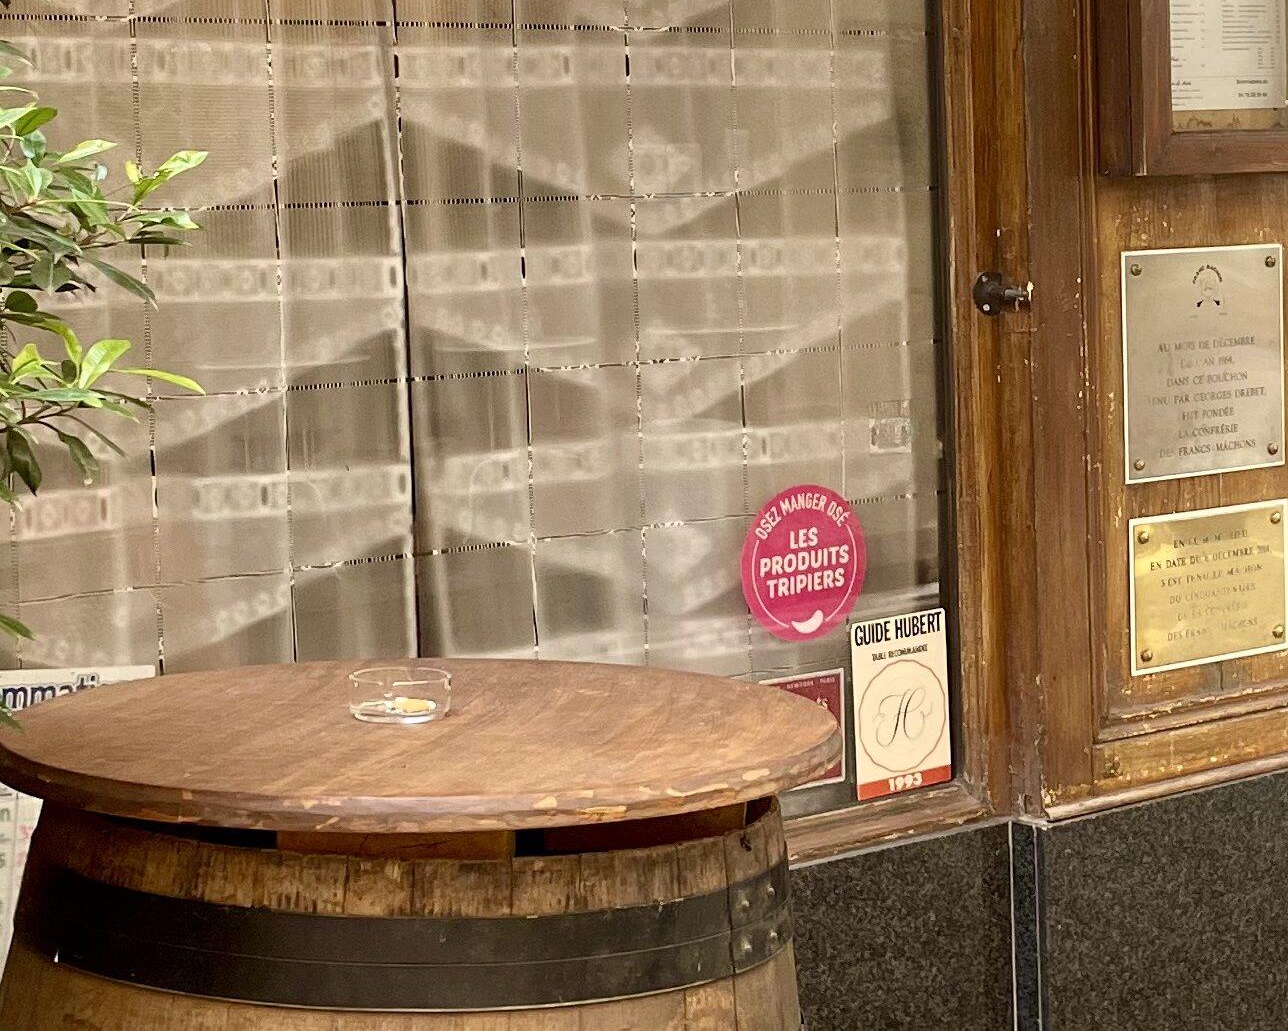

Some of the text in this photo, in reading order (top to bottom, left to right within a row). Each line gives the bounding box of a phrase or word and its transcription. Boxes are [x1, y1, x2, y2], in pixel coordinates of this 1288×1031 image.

[754, 506, 782, 540] OSEZ
[780, 492, 827, 517] MANGER
[789, 527, 818, 550] LES
[759, 544, 850, 578] PRODUITS
[766, 567, 845, 599] TRIPIERS
[854, 611, 943, 647] GUIDE HUBERT
[888, 773, 923, 792] 1993
